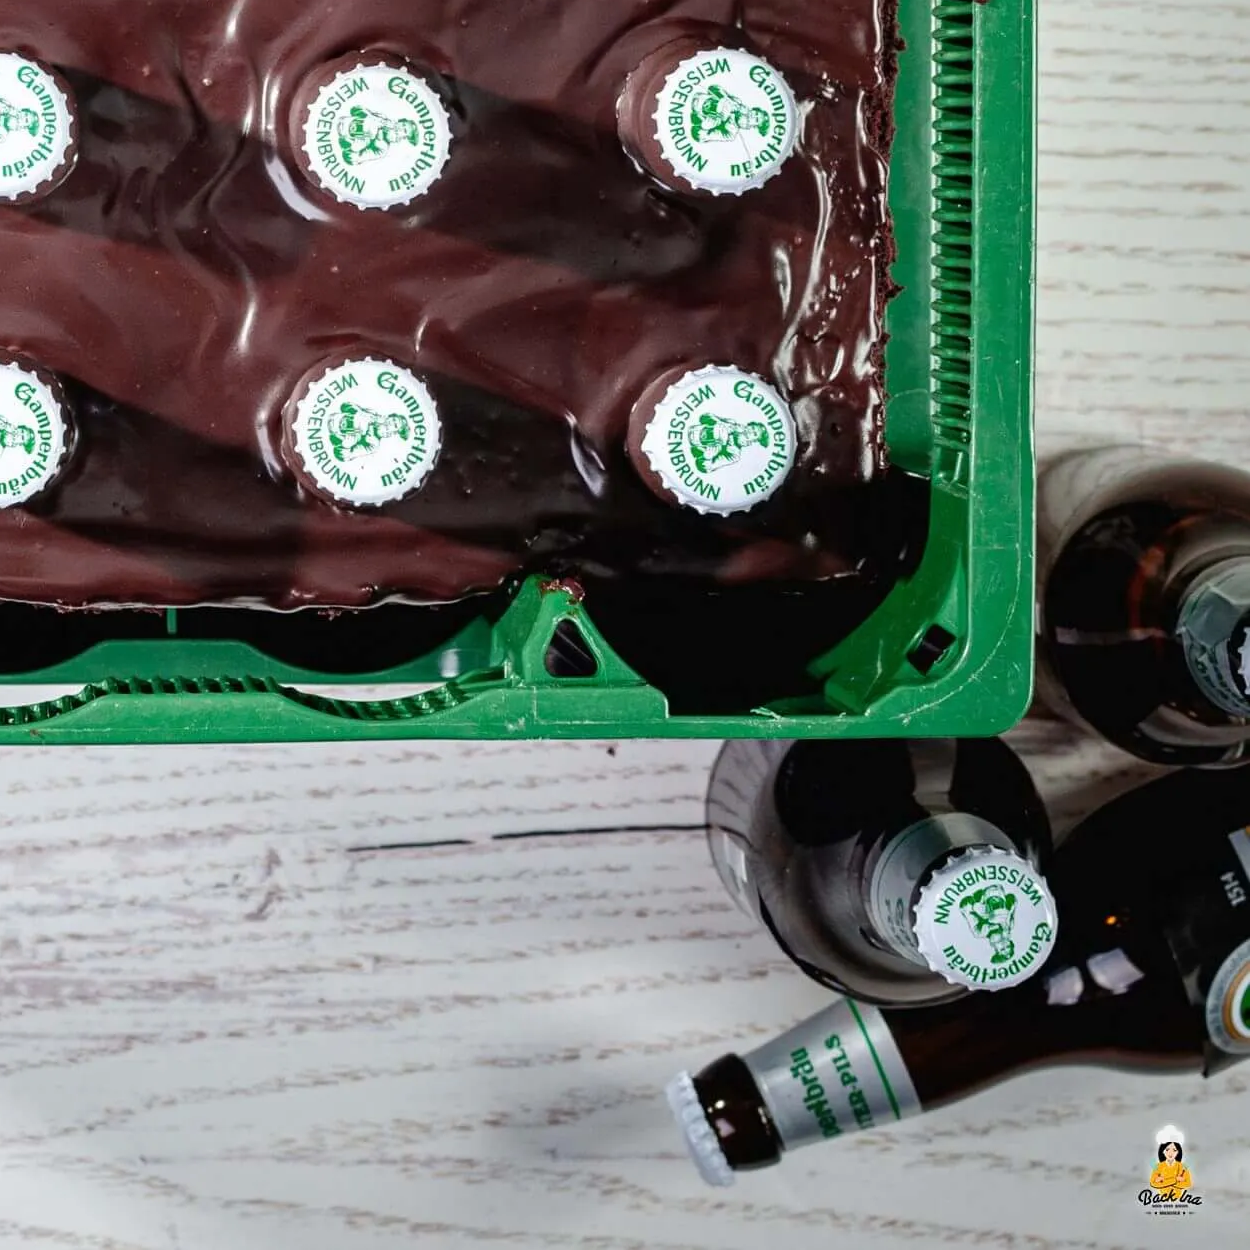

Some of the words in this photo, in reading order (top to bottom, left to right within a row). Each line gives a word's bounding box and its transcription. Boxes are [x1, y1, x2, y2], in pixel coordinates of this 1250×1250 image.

[2, 65, 57, 178] Gampertbräu
[317, 77, 367, 194] WEISSENBRUNN
[388, 76, 436, 192] Gampertbräu
[668, 58, 730, 172] WEISSENBRUNN
[730, 65, 787, 179] Gampertbräu
[307, 373, 358, 491] WEISSENBRUNN
[377, 371, 427, 486] Gampertbräu
[669, 384, 721, 501] WEISSENBRUNN
[733, 380, 787, 496] Gampertbräu
[934, 865, 1042, 925] WEISSENBRUNN
[1220, 871, 1246, 907] 1514
[943, 922, 1052, 983] Gampertbräu
